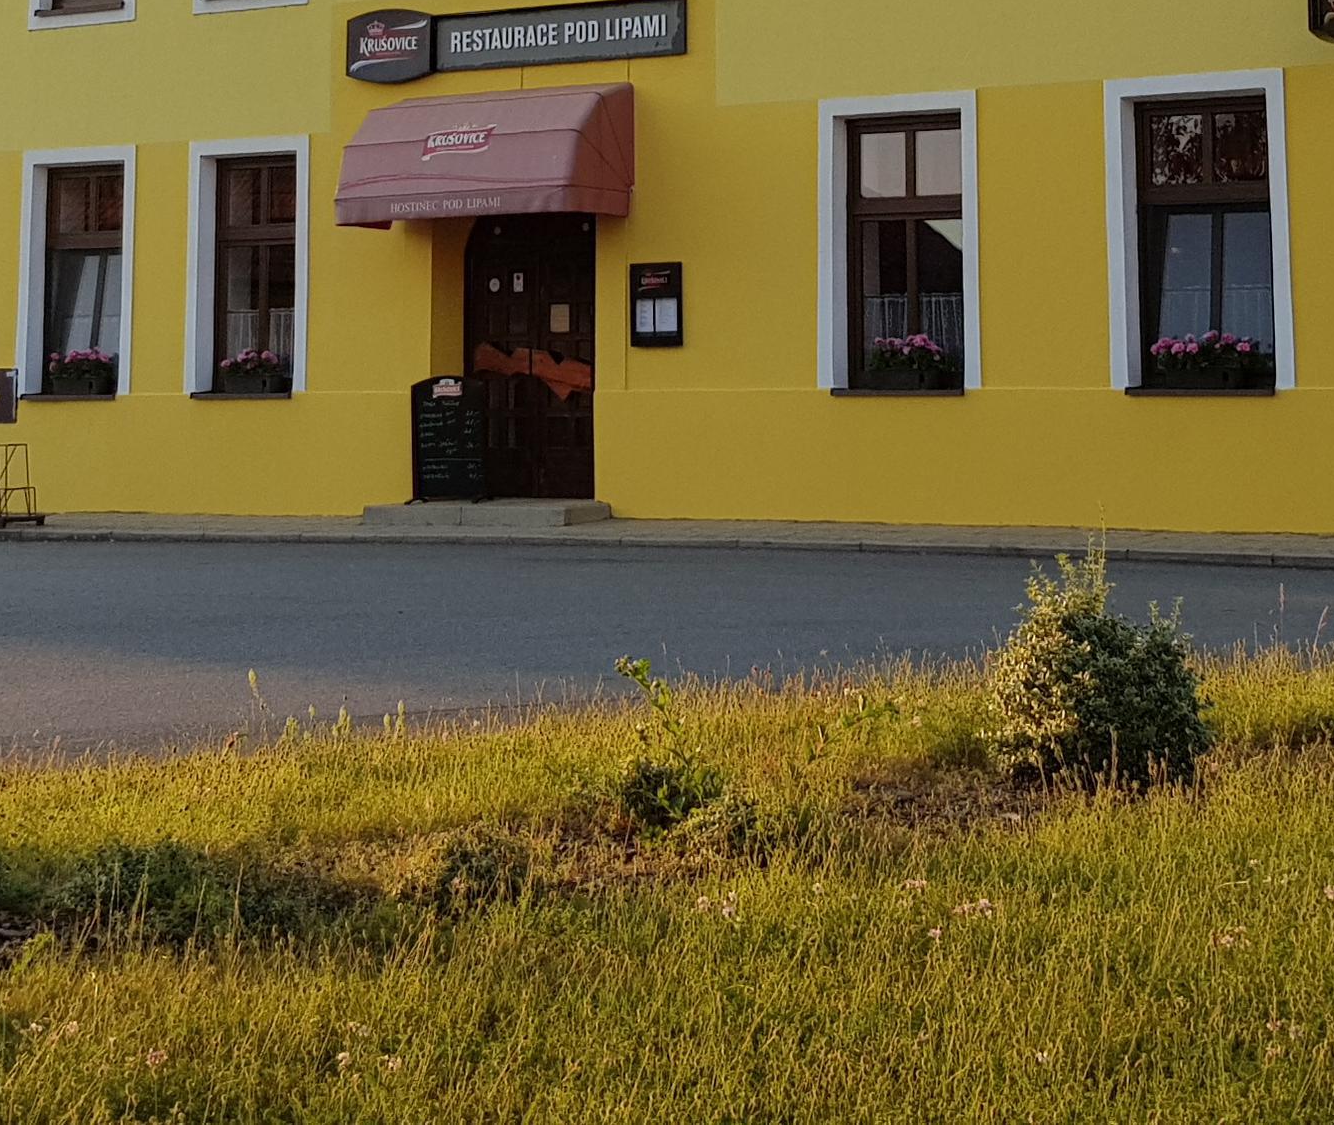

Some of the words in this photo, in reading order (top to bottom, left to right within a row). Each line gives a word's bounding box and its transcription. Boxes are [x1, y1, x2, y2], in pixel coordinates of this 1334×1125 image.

[450, 23, 558, 53] RESTAURACE
[564, 20, 599, 44] POD
[605, 13, 667, 41] LIPAMI
[390, 200, 440, 213] HOSTINEC
[442, 198, 463, 210] POD
[466, 196, 501, 209] LIPAMI
